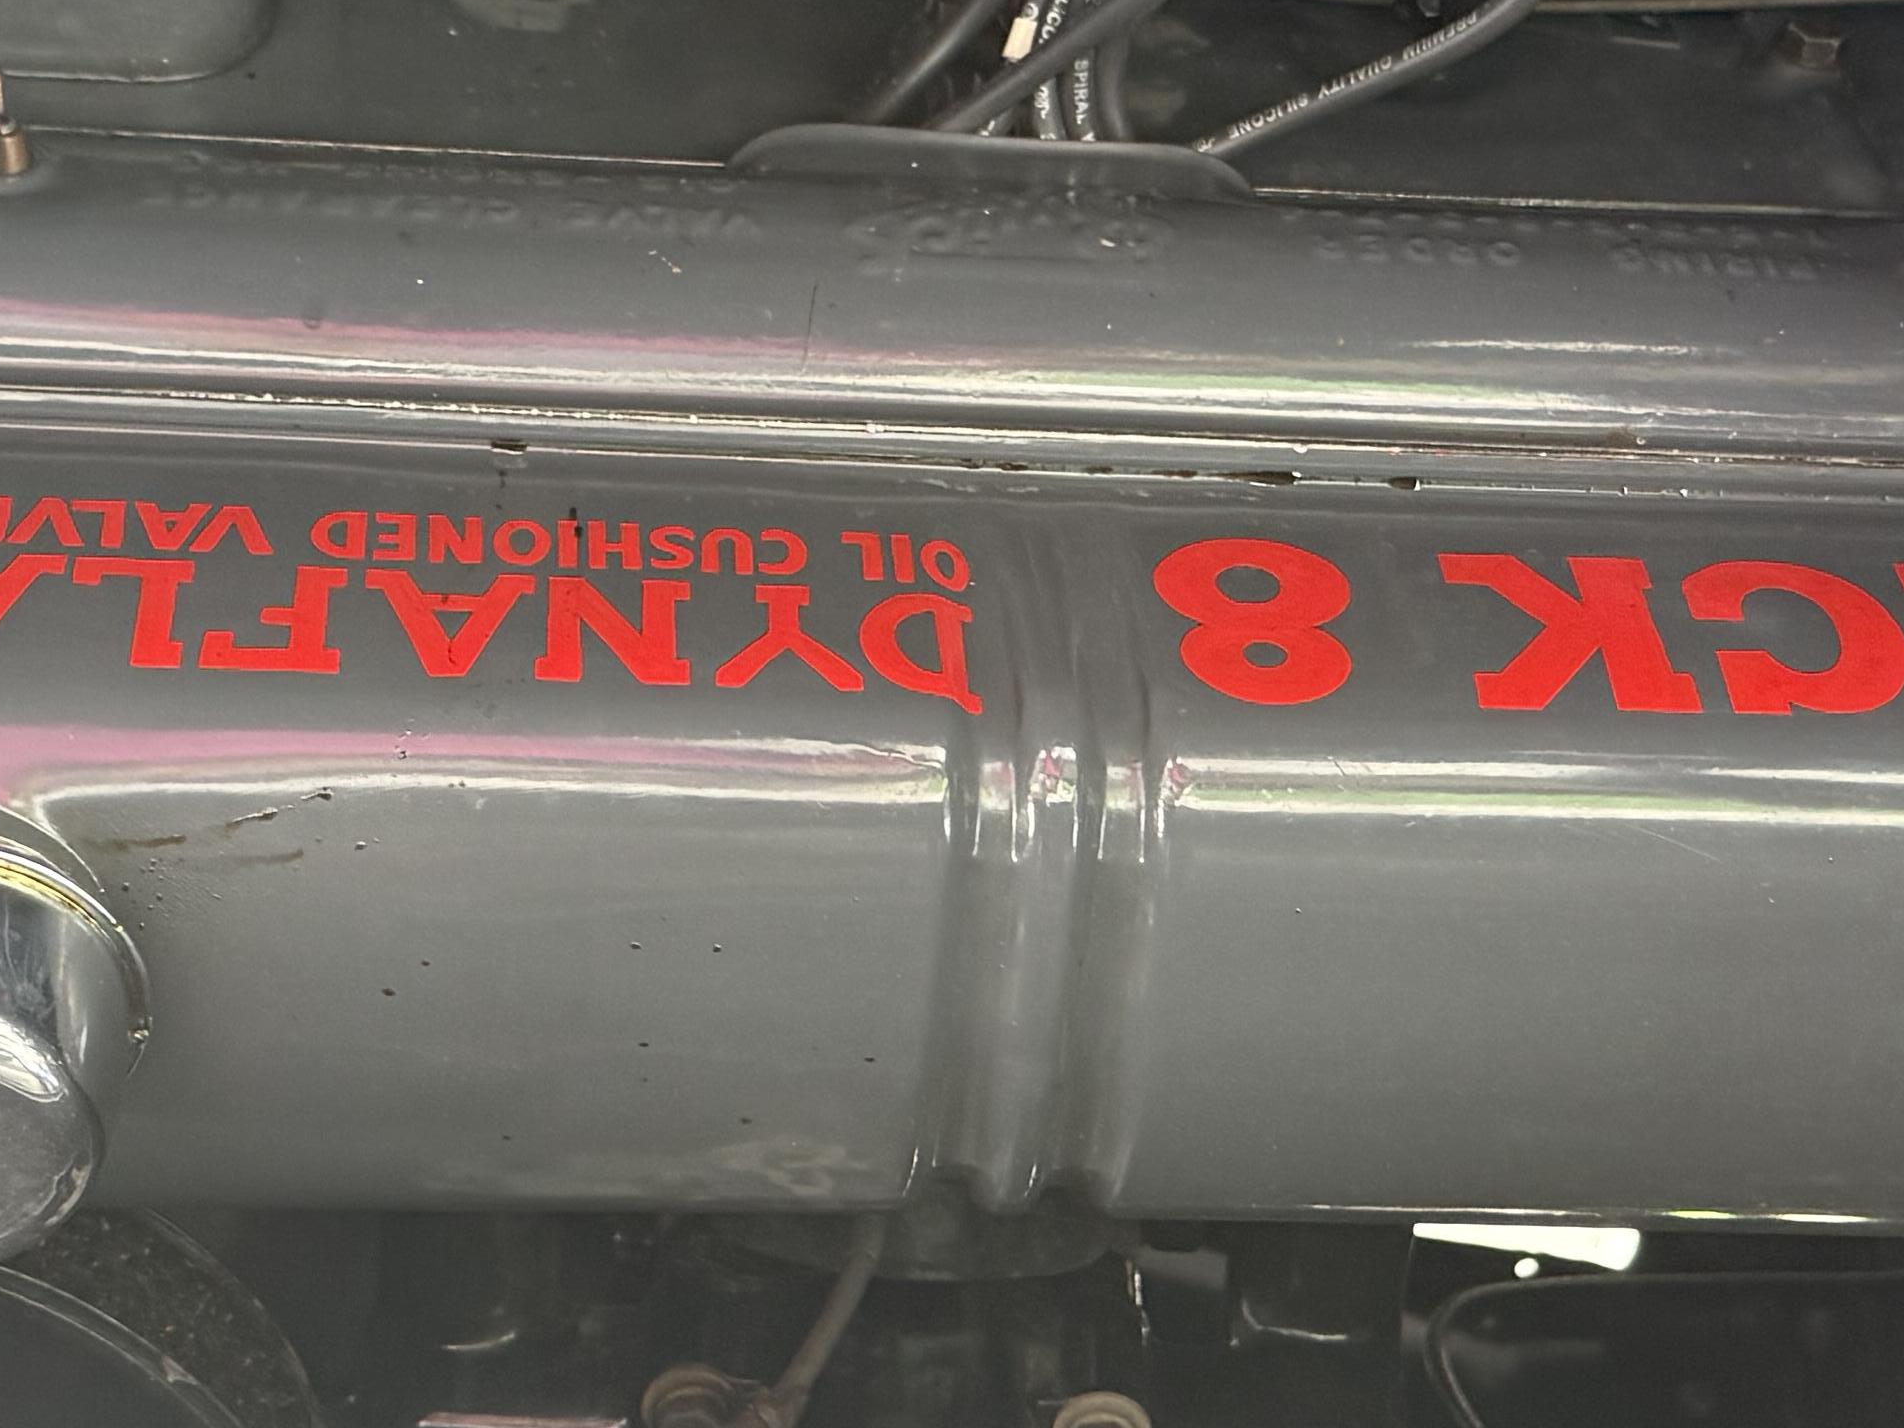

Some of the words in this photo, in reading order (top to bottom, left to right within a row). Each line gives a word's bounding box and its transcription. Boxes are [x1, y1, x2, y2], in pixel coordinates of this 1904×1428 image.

[1072, 58, 1091, 125] SPIRAL
[1317, 55, 1393, 99] QUALITY
[1226, 96, 1309, 142] SILICONE
[1310, 234, 1522, 269] ORDER
[308, 509, 809, 576] CUSHIONED
[839, 529, 971, 592] OIL
[1151, 536, 1353, 706] 8
